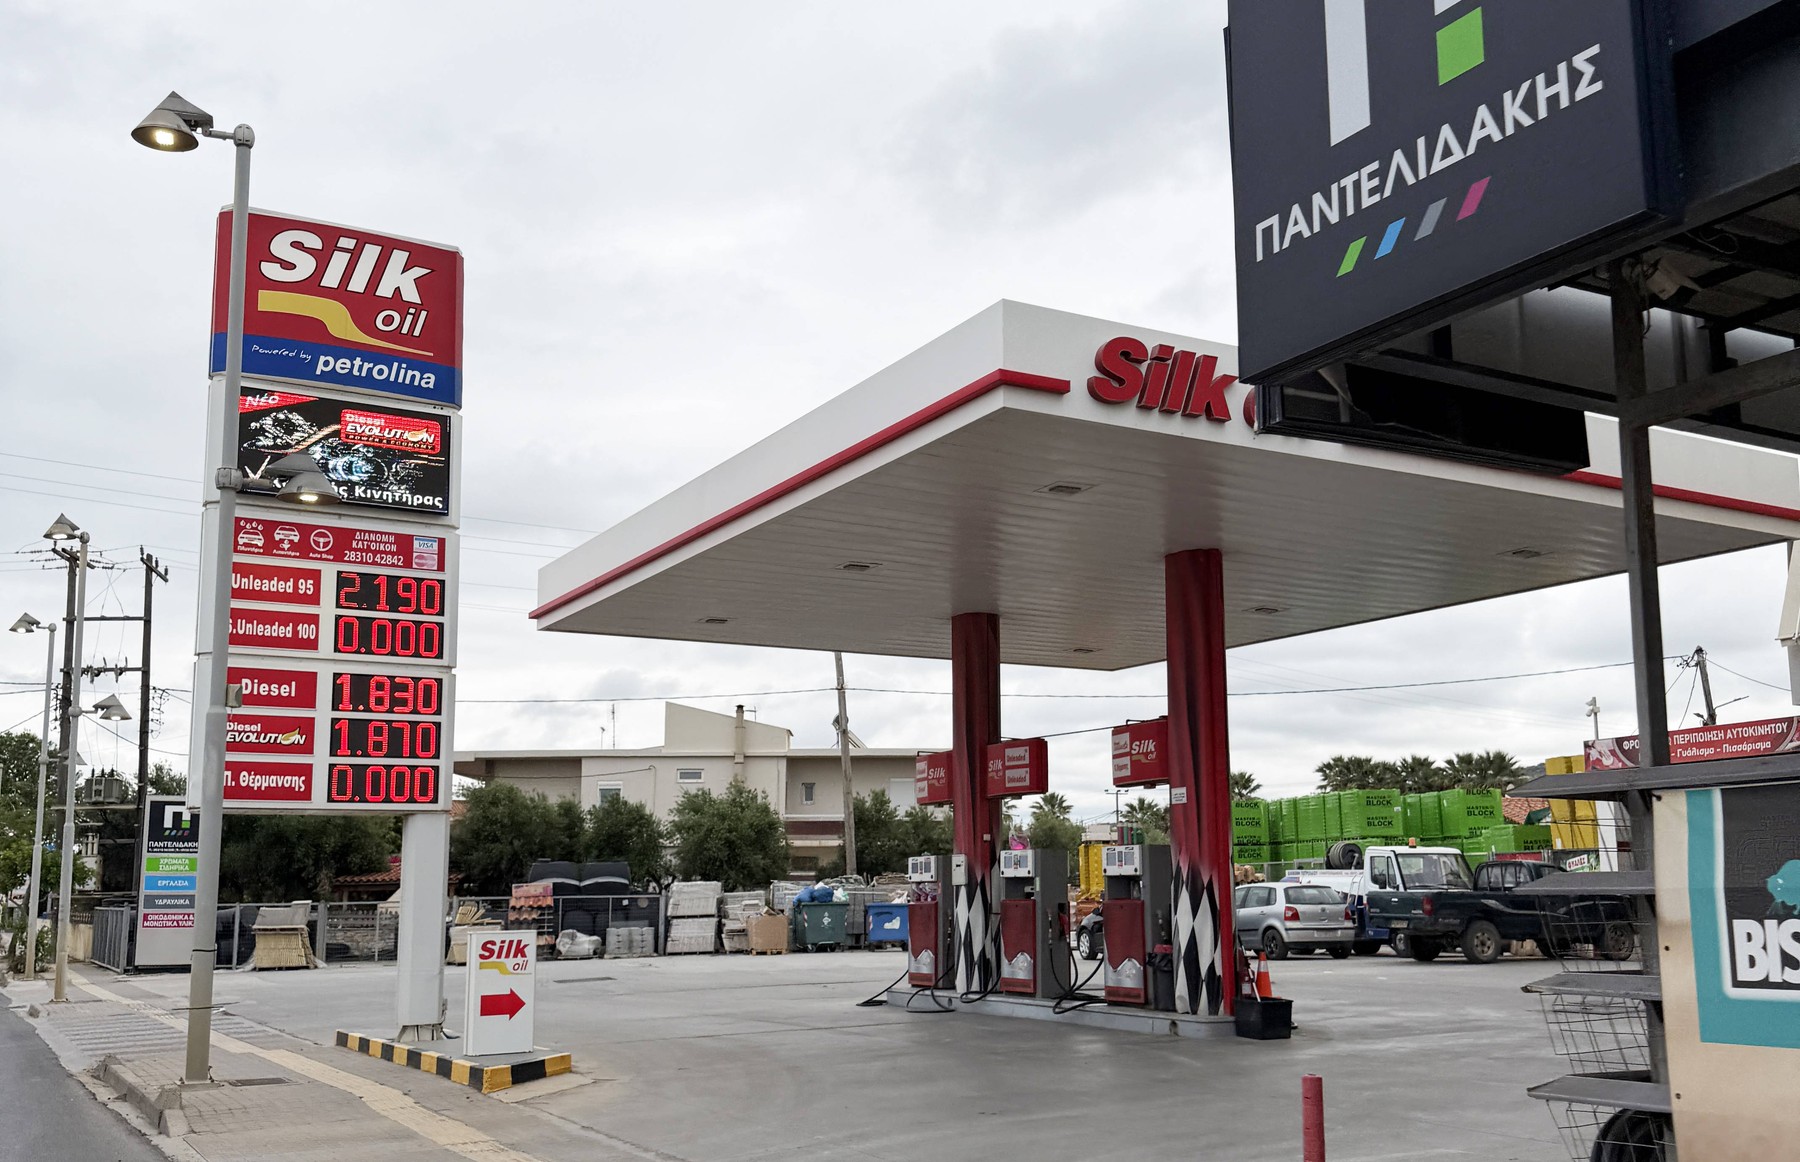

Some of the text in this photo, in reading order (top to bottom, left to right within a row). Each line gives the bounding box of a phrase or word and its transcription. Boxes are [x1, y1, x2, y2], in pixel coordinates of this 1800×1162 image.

[1255, 43, 1603, 262] ΠΑΝΤΕΛΙΔΑΚΗΣ
[259, 229, 436, 305] Silk
[374, 307, 428, 338] oil
[252, 344, 436, 389] Powered by petrolina
[1086, 336, 1239, 423] Silk
[345, 422, 435, 443] EVOLUTION
[354, 485, 443, 508] Κινητήρας
[355, 531, 395, 543] ΔΙΑΝΟΜΗ
[418, 541, 434, 549] VISA
[343, 550, 404, 566] 28310 42842
[231, 573, 314, 595] Unleaded 95
[339, 572, 441, 615] 2.190
[297, 622, 316, 640] 100
[337, 616, 440, 658] 0.000
[241, 678, 296, 698] Diesel
[336, 673, 438, 714] 1.830
[226, 721, 261, 732] Diesel
[1673, 729, 1725, 745] ΠΕΡΙΠΟΙΗΣΗ
[1726, 722, 1789, 740] ΑΥΤΟΚΙΝΗΤΟΥ
[226, 730, 307, 745] EVOLUTION
[334, 719, 436, 758] 1.870
[1131, 739, 1156, 754] Silk
[1677, 745, 1715, 758] Γυάλισμα
[1722, 740, 1772, 754] Πισσάρισμα
[928, 767, 946, 779] Silk
[988, 759, 1003, 772] Silk
[223, 770, 306, 792] Π. Θέρμανσης
[331, 764, 434, 803] 0.000
[1235, 801, 1260, 809] BLOCK
[478, 939, 530, 960] Silk
[512, 959, 529, 971] oil
